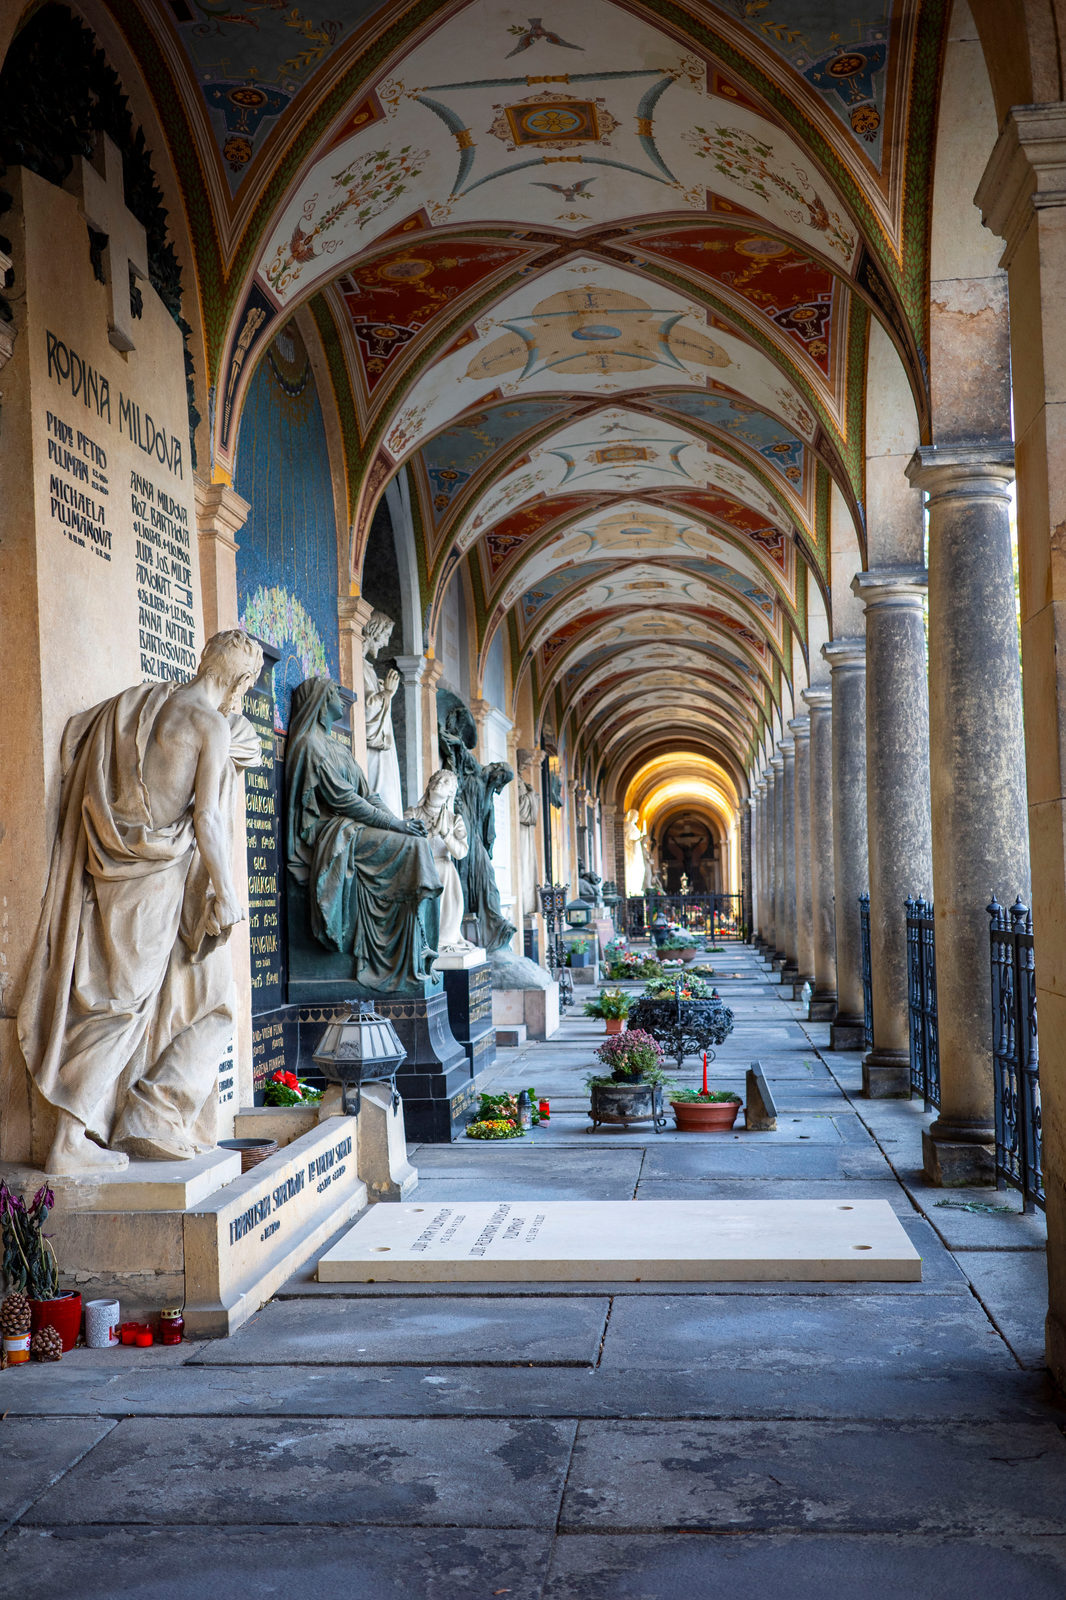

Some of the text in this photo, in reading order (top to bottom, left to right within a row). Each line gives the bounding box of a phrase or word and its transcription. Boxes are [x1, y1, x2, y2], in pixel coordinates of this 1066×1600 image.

[46, 329, 111, 425] RODINA
[47, 438, 89, 484] PUJMAN
[50, 474, 105, 526] MICHAELA
[130, 470, 154, 503] ANNA
[139, 606, 162, 635] ANNA
